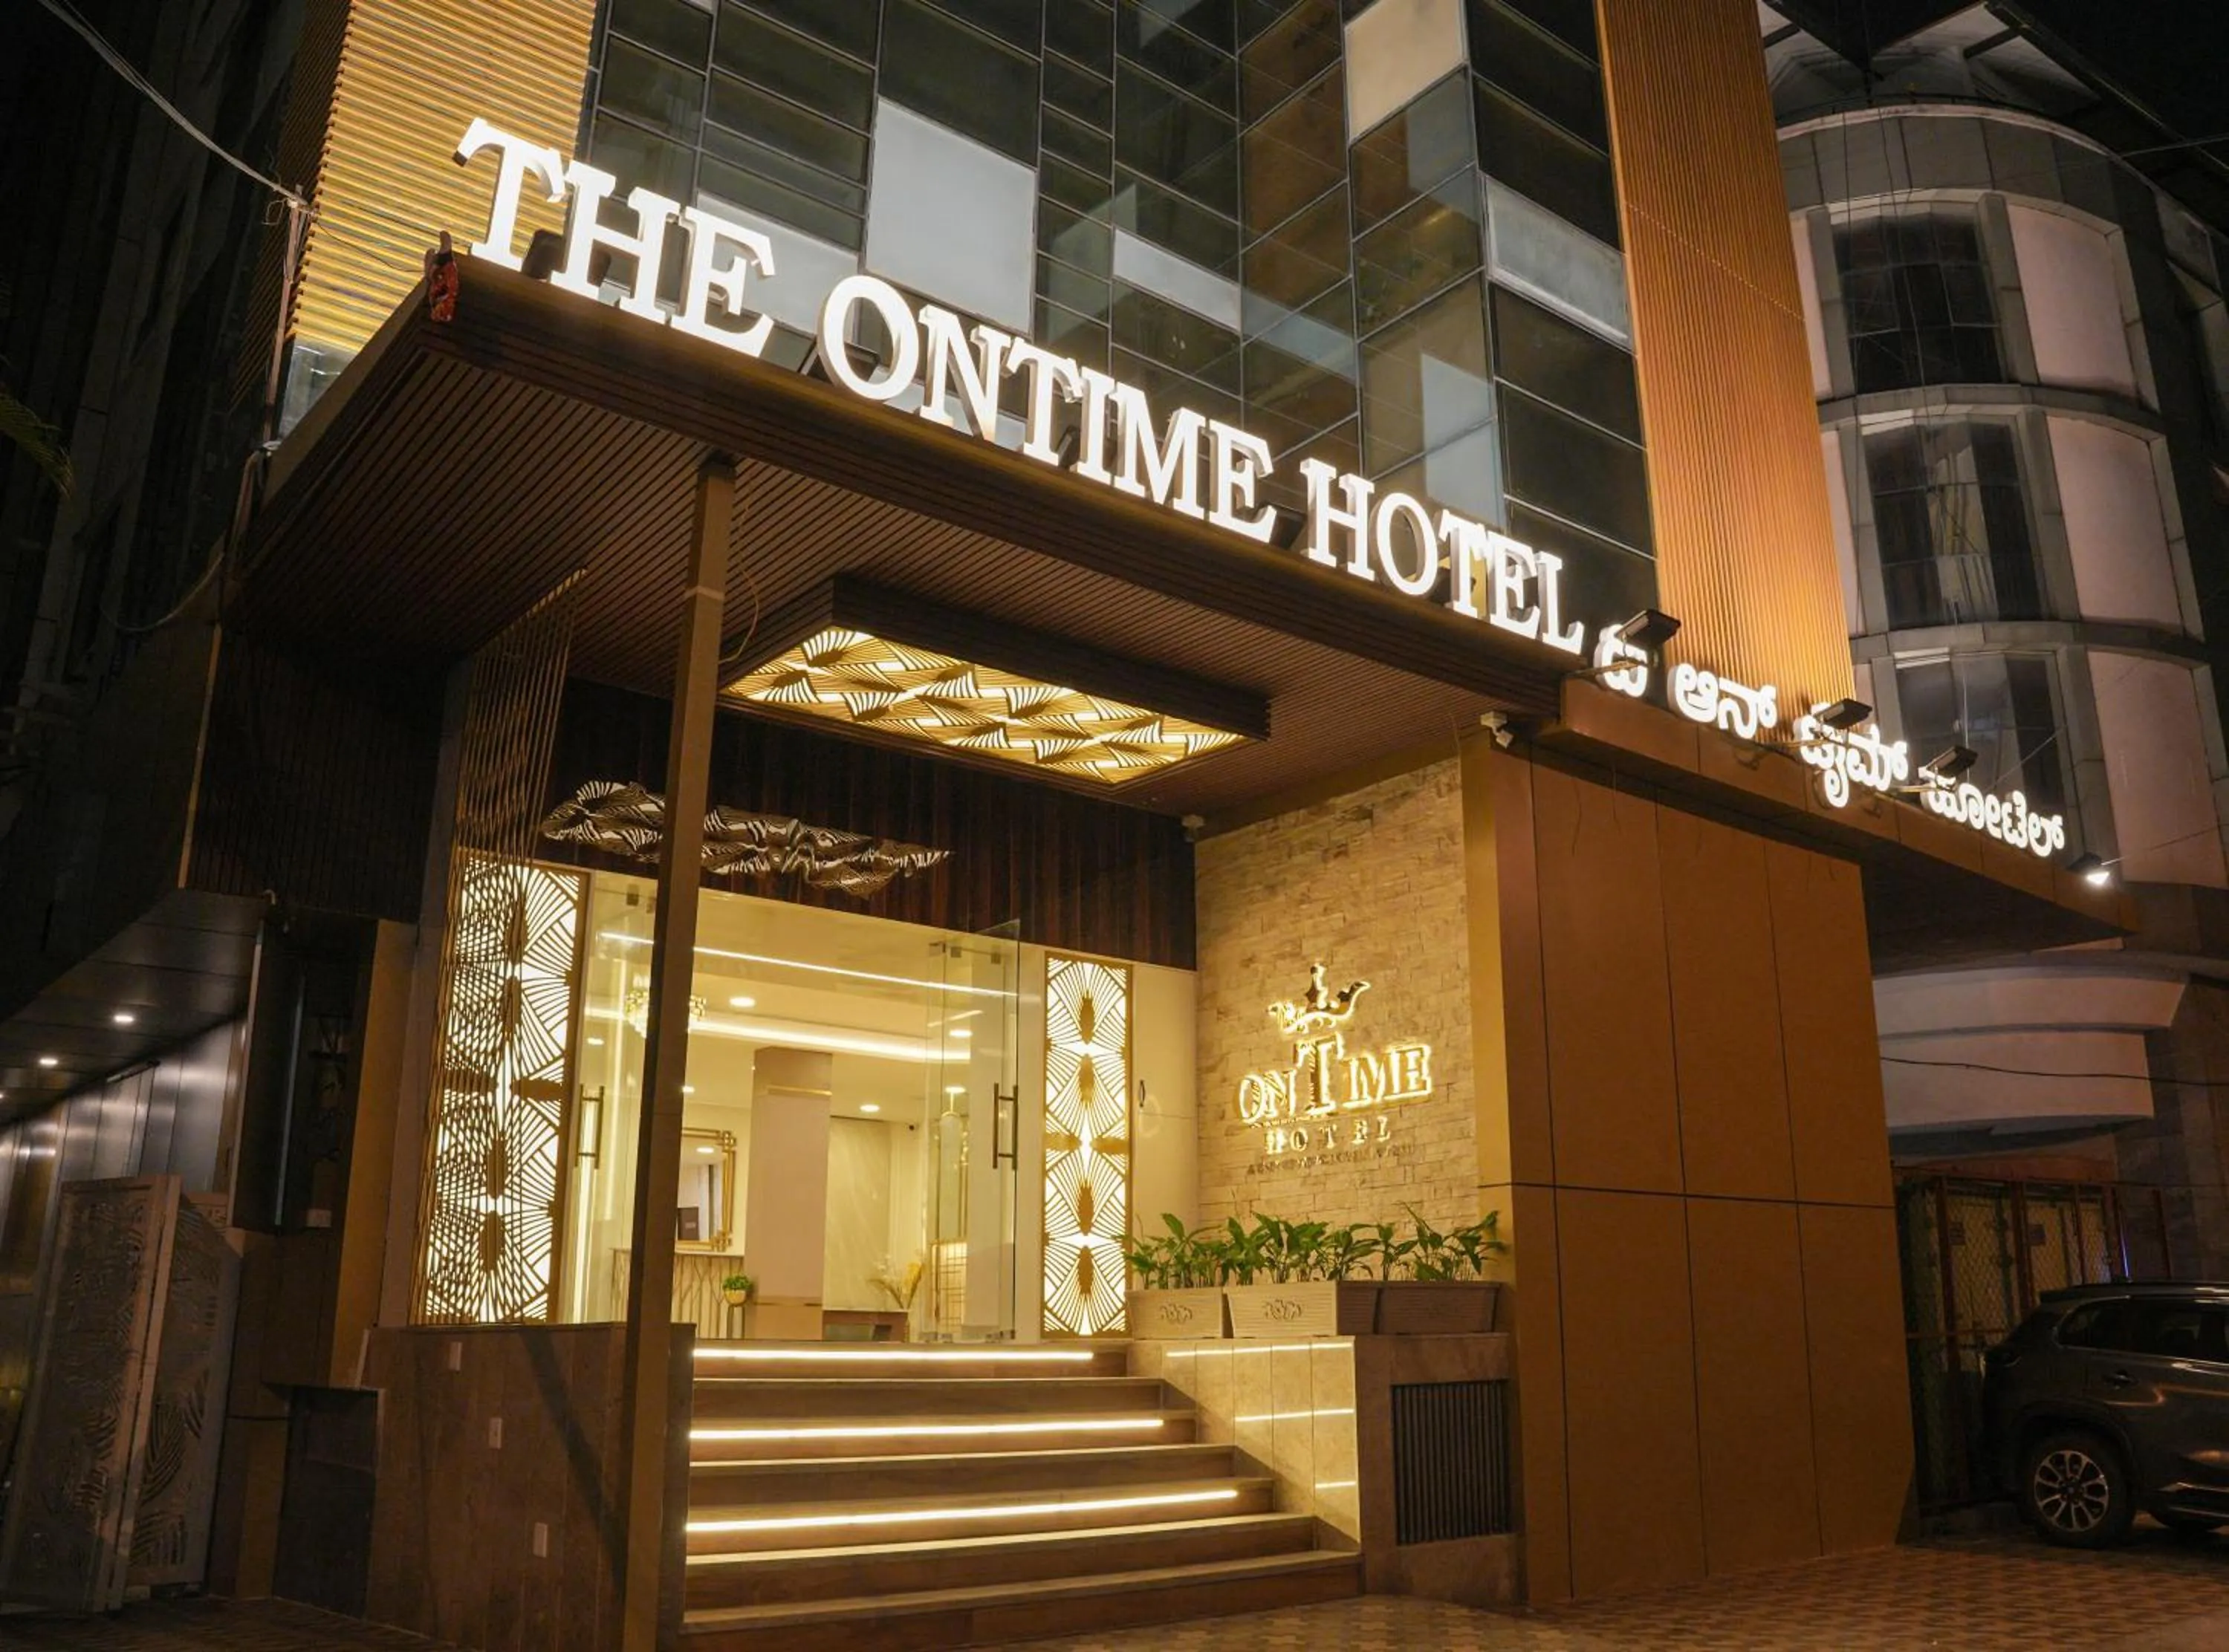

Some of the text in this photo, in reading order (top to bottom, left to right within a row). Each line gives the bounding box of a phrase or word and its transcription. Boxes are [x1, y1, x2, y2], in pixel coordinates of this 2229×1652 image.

[453, 117, 1585, 654] THE ONTIME HOTEL
[1667, 663, 1778, 739] ಆನ್
[1918, 767, 2065, 857] ಹೋಟೆಲ್
[1265, 1116, 1390, 1154] HOTEL
